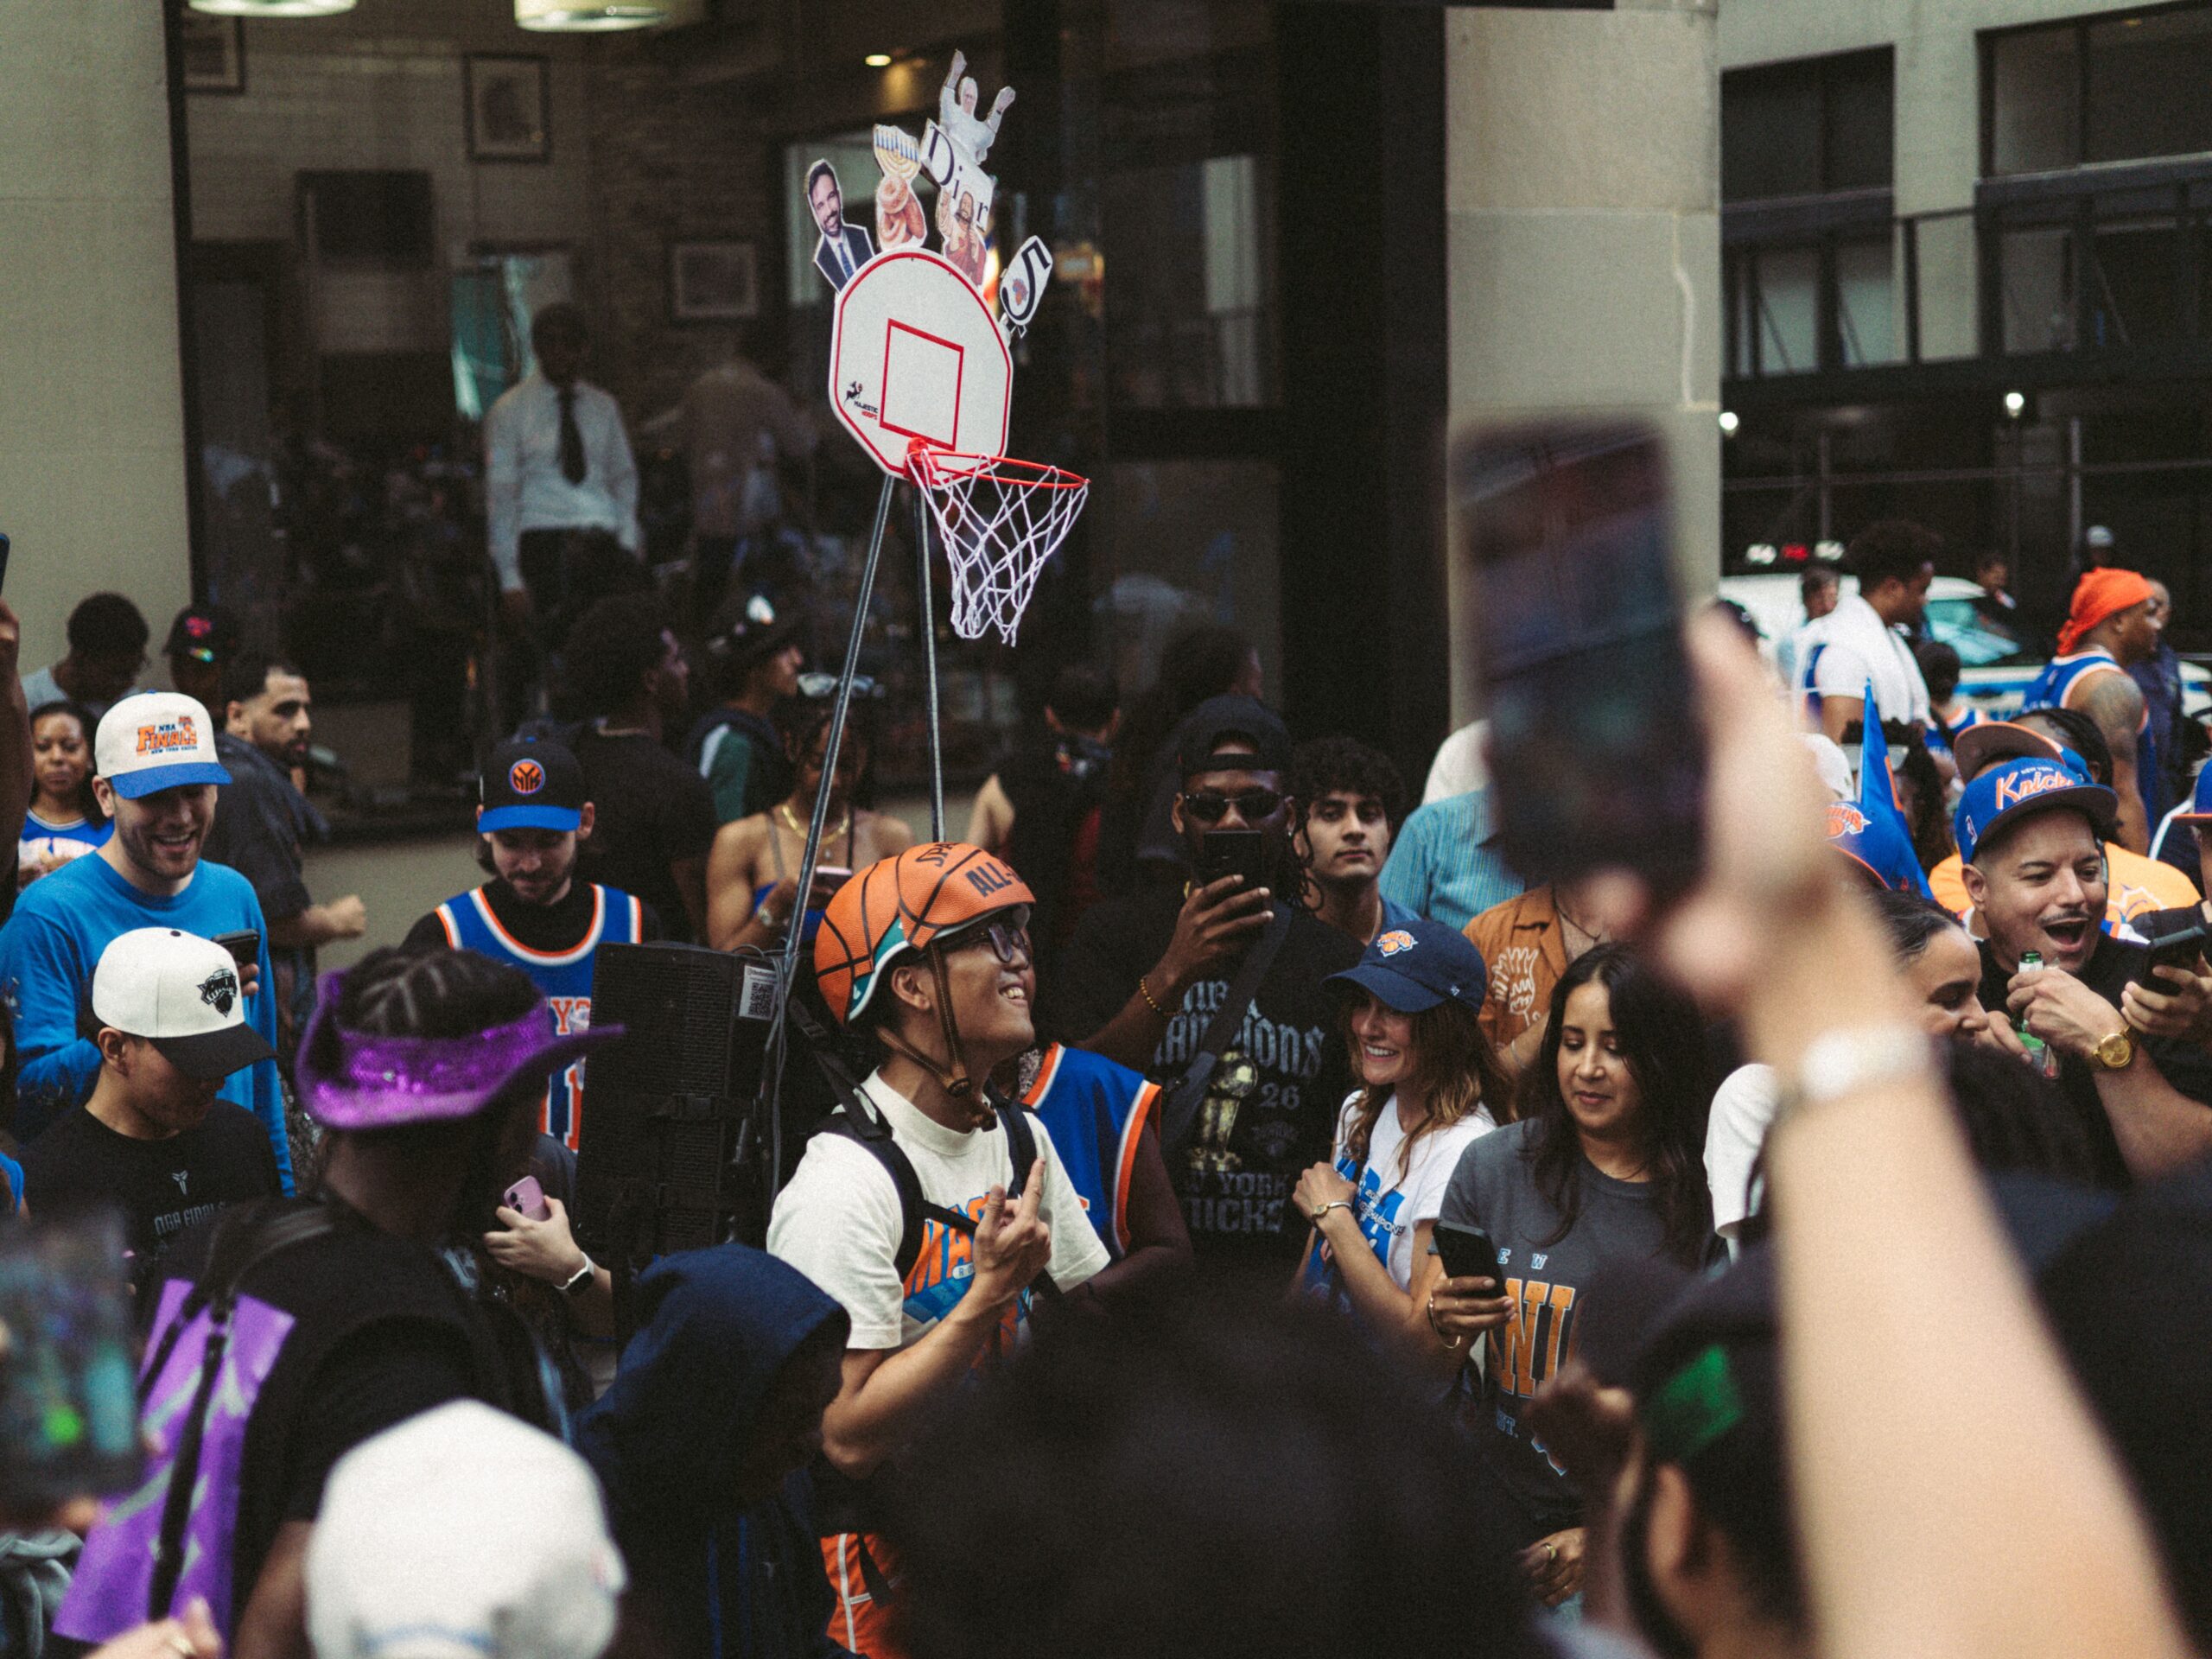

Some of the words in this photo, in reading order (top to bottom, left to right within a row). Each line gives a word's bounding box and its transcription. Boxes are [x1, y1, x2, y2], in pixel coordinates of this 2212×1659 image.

[928, 124, 988, 232] Dir
[136, 724, 198, 752] FINALS
[158, 723, 176, 732] NBA
[1259, 1082, 1300, 1110] 26
